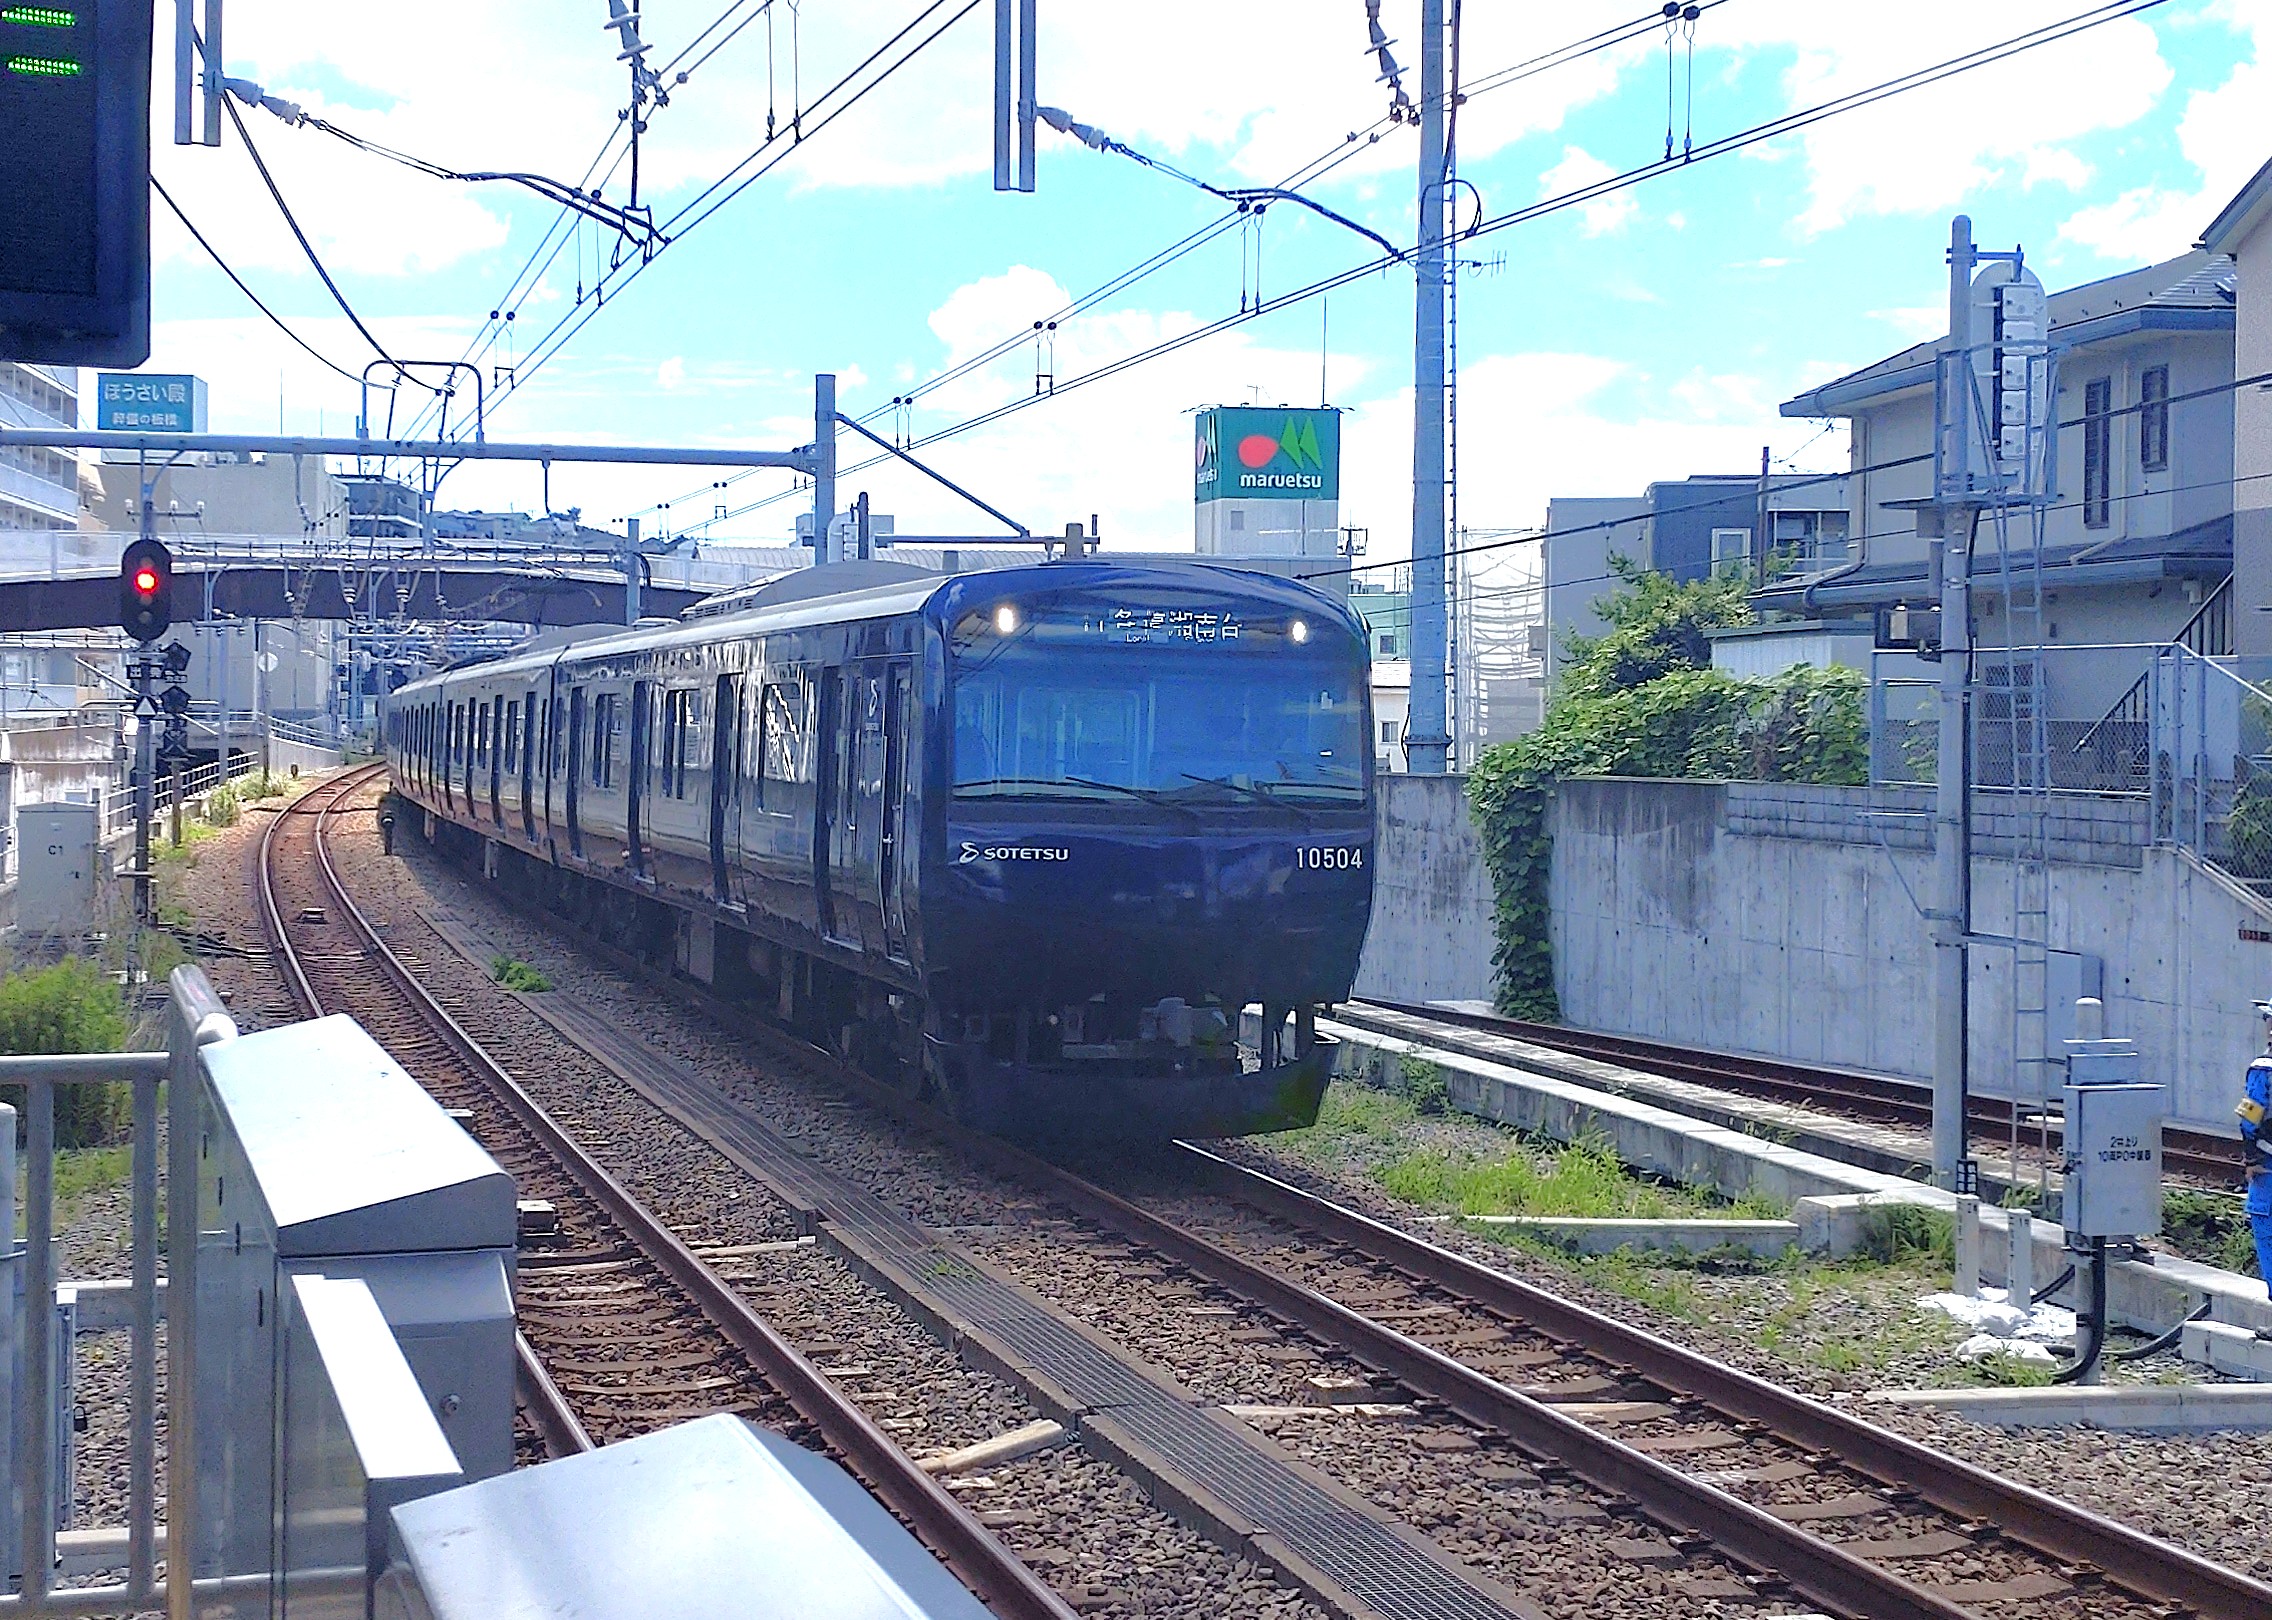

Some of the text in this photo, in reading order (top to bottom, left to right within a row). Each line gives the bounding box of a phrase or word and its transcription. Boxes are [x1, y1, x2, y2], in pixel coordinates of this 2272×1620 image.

[104, 383, 185, 403] ほうさい殿
[1240, 472, 1322, 488] maruetsu
[984, 847, 1068, 860] SOTETSU
[1297, 847, 1363, 869] 10504
